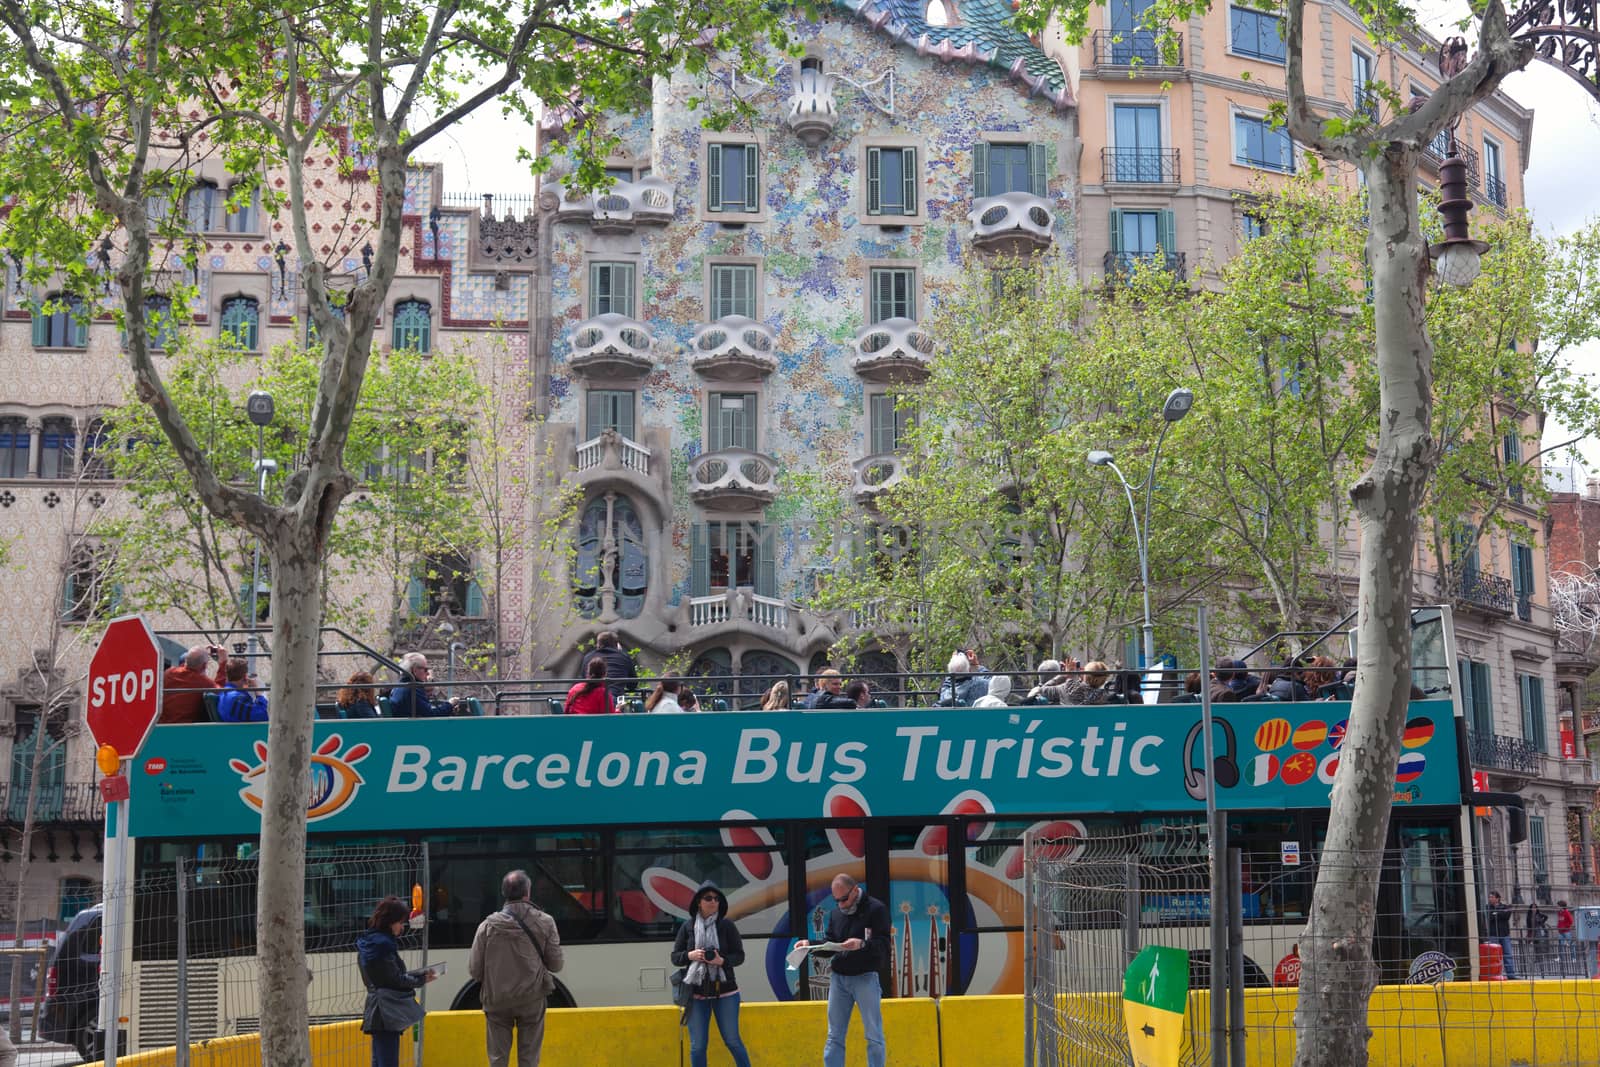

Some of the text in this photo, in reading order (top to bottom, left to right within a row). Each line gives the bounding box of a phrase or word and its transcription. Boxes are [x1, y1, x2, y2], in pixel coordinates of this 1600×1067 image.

[91, 669, 154, 707] STOP
[386, 719, 1164, 794] Barcelona Bus Turístic
[1407, 960, 1453, 984] OFFICIAL
